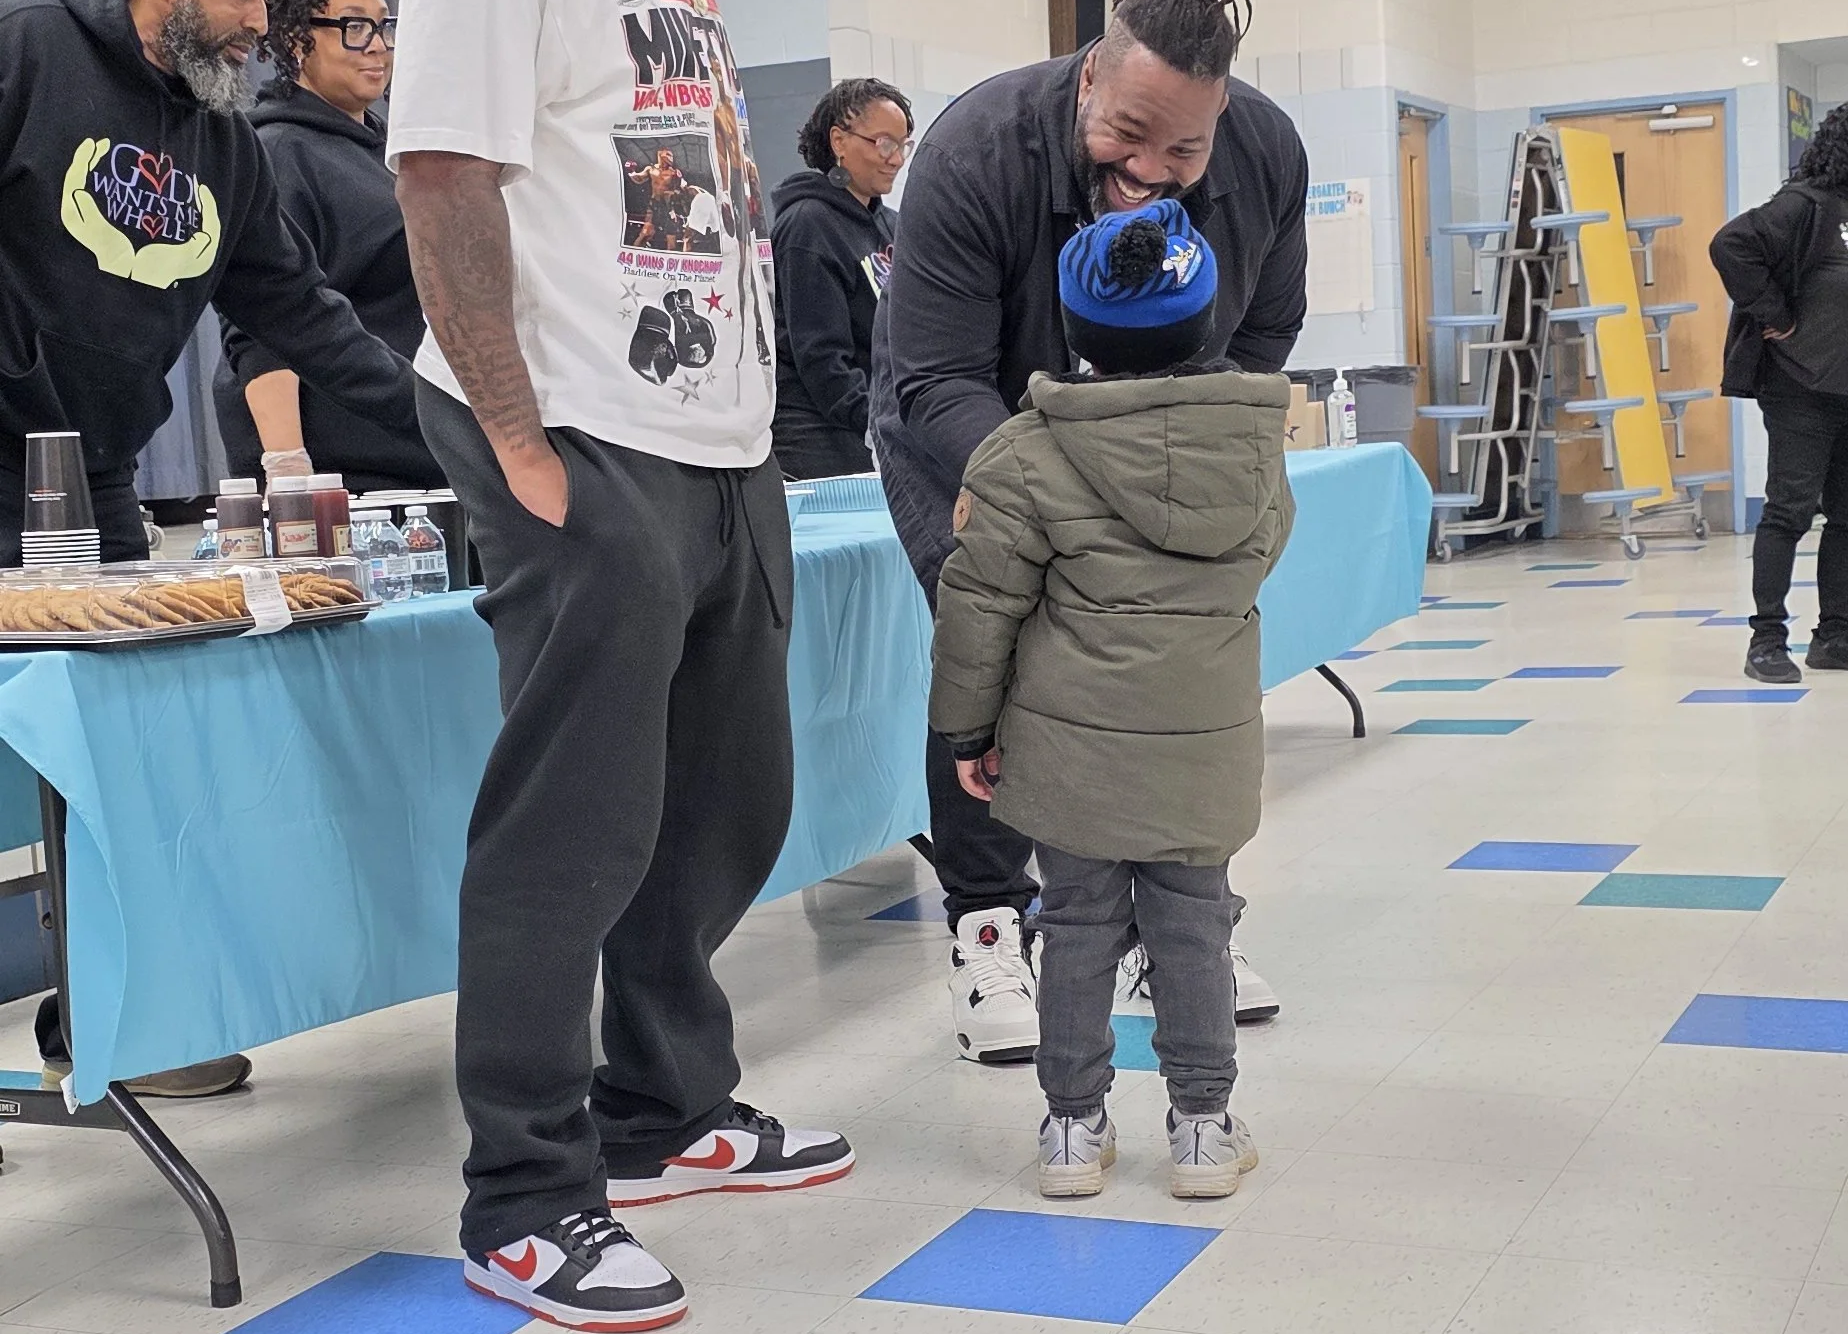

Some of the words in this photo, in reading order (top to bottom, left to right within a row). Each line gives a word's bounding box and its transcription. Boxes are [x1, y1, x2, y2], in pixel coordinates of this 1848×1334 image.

[93, 171, 170, 216] WANTS
[175, 202, 199, 229] ME
[636, 253, 665, 271] WINS
